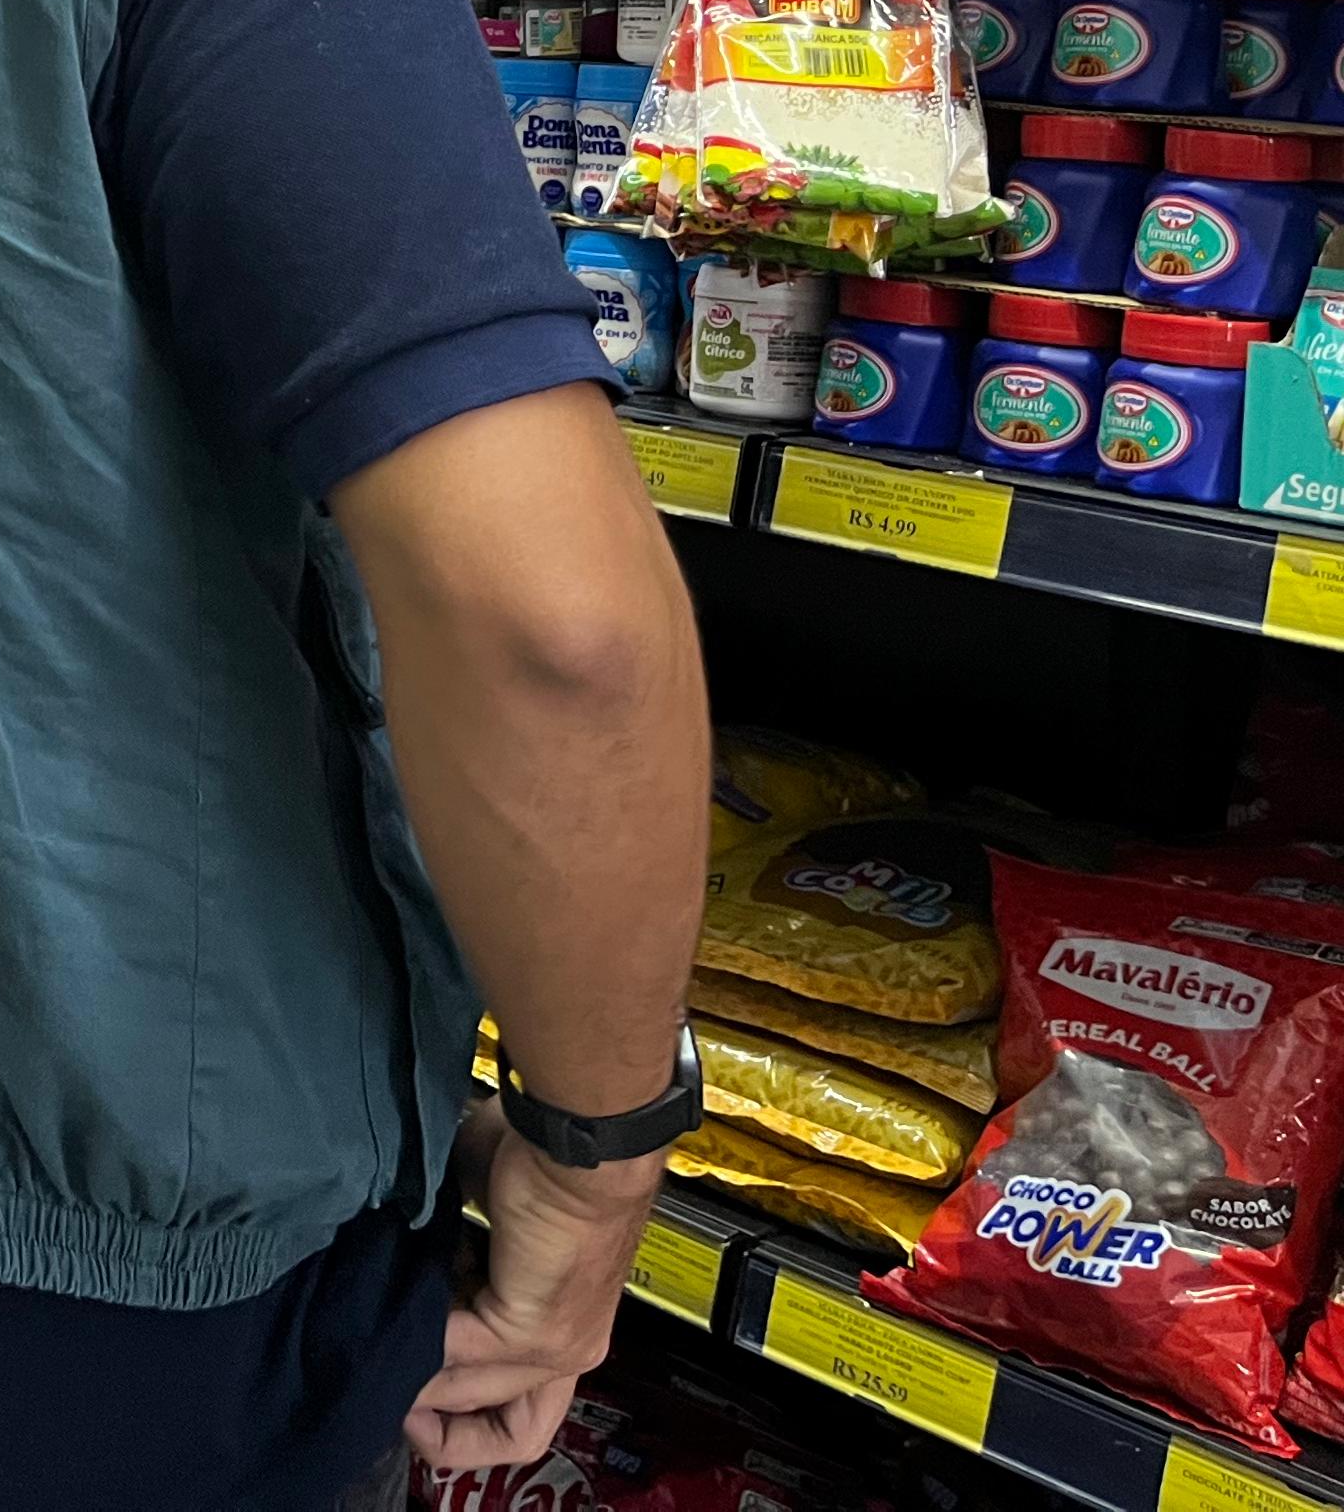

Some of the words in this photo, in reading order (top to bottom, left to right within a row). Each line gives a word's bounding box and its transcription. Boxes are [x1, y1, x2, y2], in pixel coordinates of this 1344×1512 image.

[527, 157, 562, 165] MENTO
[700, 328, 731, 345] Ácido
[704, 344, 745, 360] Cítrico
[803, 475, 850, 491] FERMENTO
[849, 508, 874, 530] R$
[878, 513, 916, 538] 4,99
[1050, 947, 1256, 1016] Mavalério
[1042, 1019, 1144, 1053] EREAL
[1148, 1043, 1217, 1093] BALL
[1008, 1178, 1095, 1210] CHOCO
[1209, 1198, 1272, 1215] SABOR
[1190, 1204, 1293, 1230] CHOCOLATE
[983, 1199, 1164, 1265] POWER
[1056, 1257, 1117, 1283] BALL
[860, 1371, 909, 1403] 25,59
